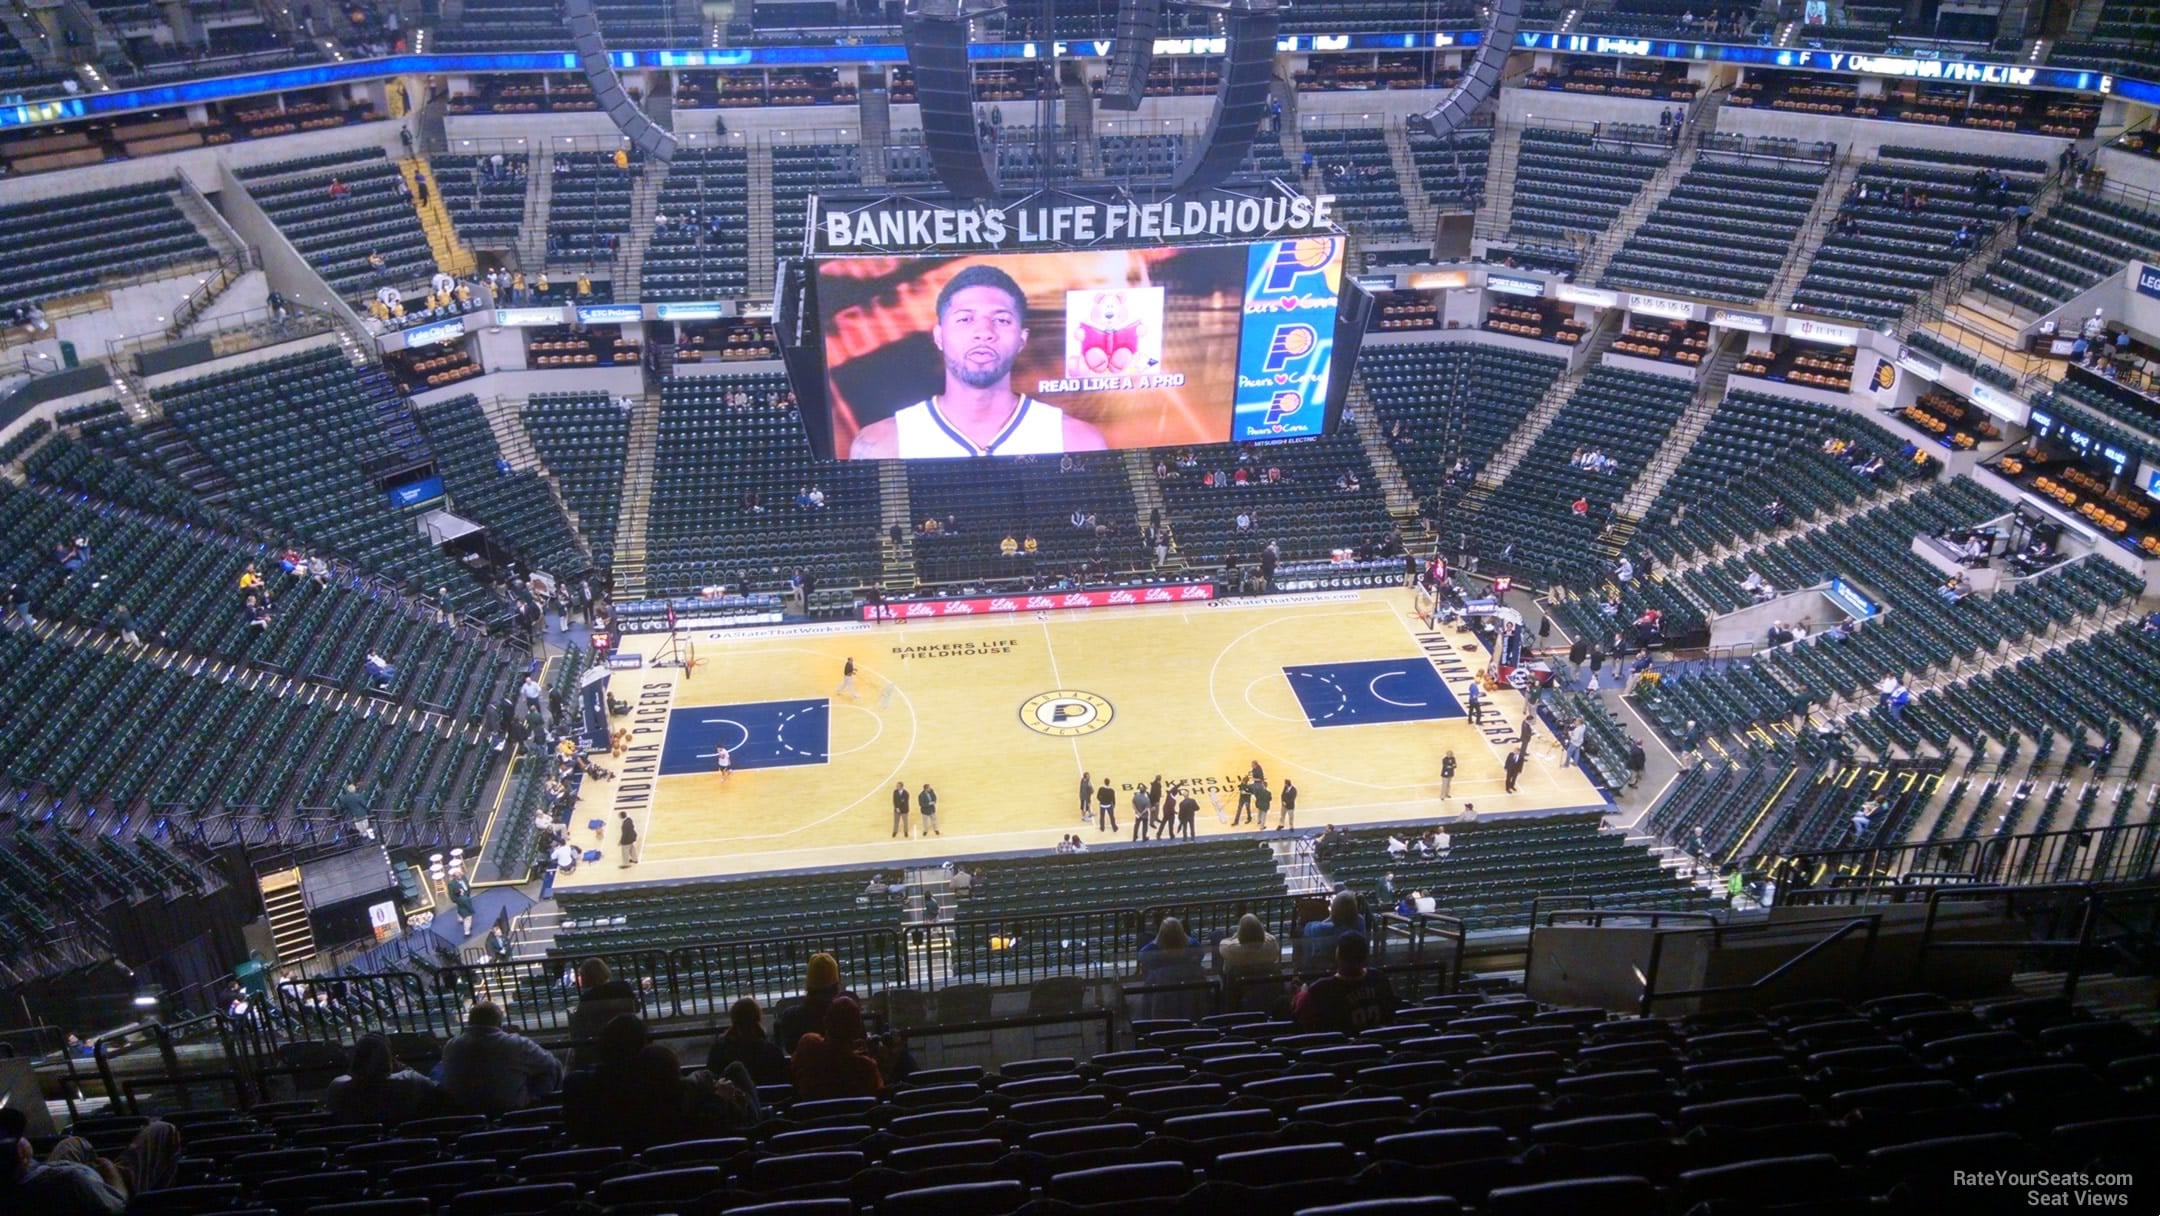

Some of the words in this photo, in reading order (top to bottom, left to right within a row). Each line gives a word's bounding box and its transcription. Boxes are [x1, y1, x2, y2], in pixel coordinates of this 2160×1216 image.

[827, 208, 1006, 246] BANKERS
[1018, 205, 1097, 243] LIFE
[1106, 195, 1336, 239] FIELDHOUSE
[1039, 380, 1080, 393] READ
[1083, 378, 1119, 391] LIKE
[1138, 376, 1151, 389] A
[1152, 374, 1185, 387] PRO
[906, 603, 935, 617] Lilly
[944, 601, 974, 614] Lilly
[988, 598, 1018, 611] Lilly
[1026, 596, 1056, 608] Lilly
[1063, 593, 1092, 606] Lilly
[1107, 590, 1136, 603] Lilly
[1144, 588, 1172, 601] Lilly
[1180, 586, 1209, 599] Lilly
[892, 642, 976, 654] BANKERS
[983, 639, 1019, 648] LIFE
[901, 646, 1012, 660] FIELDHOUSE
[632, 682, 673, 735] PACERS
[614, 743, 660, 811] INDIANA
[1122, 775, 1217, 792] BAKERS
